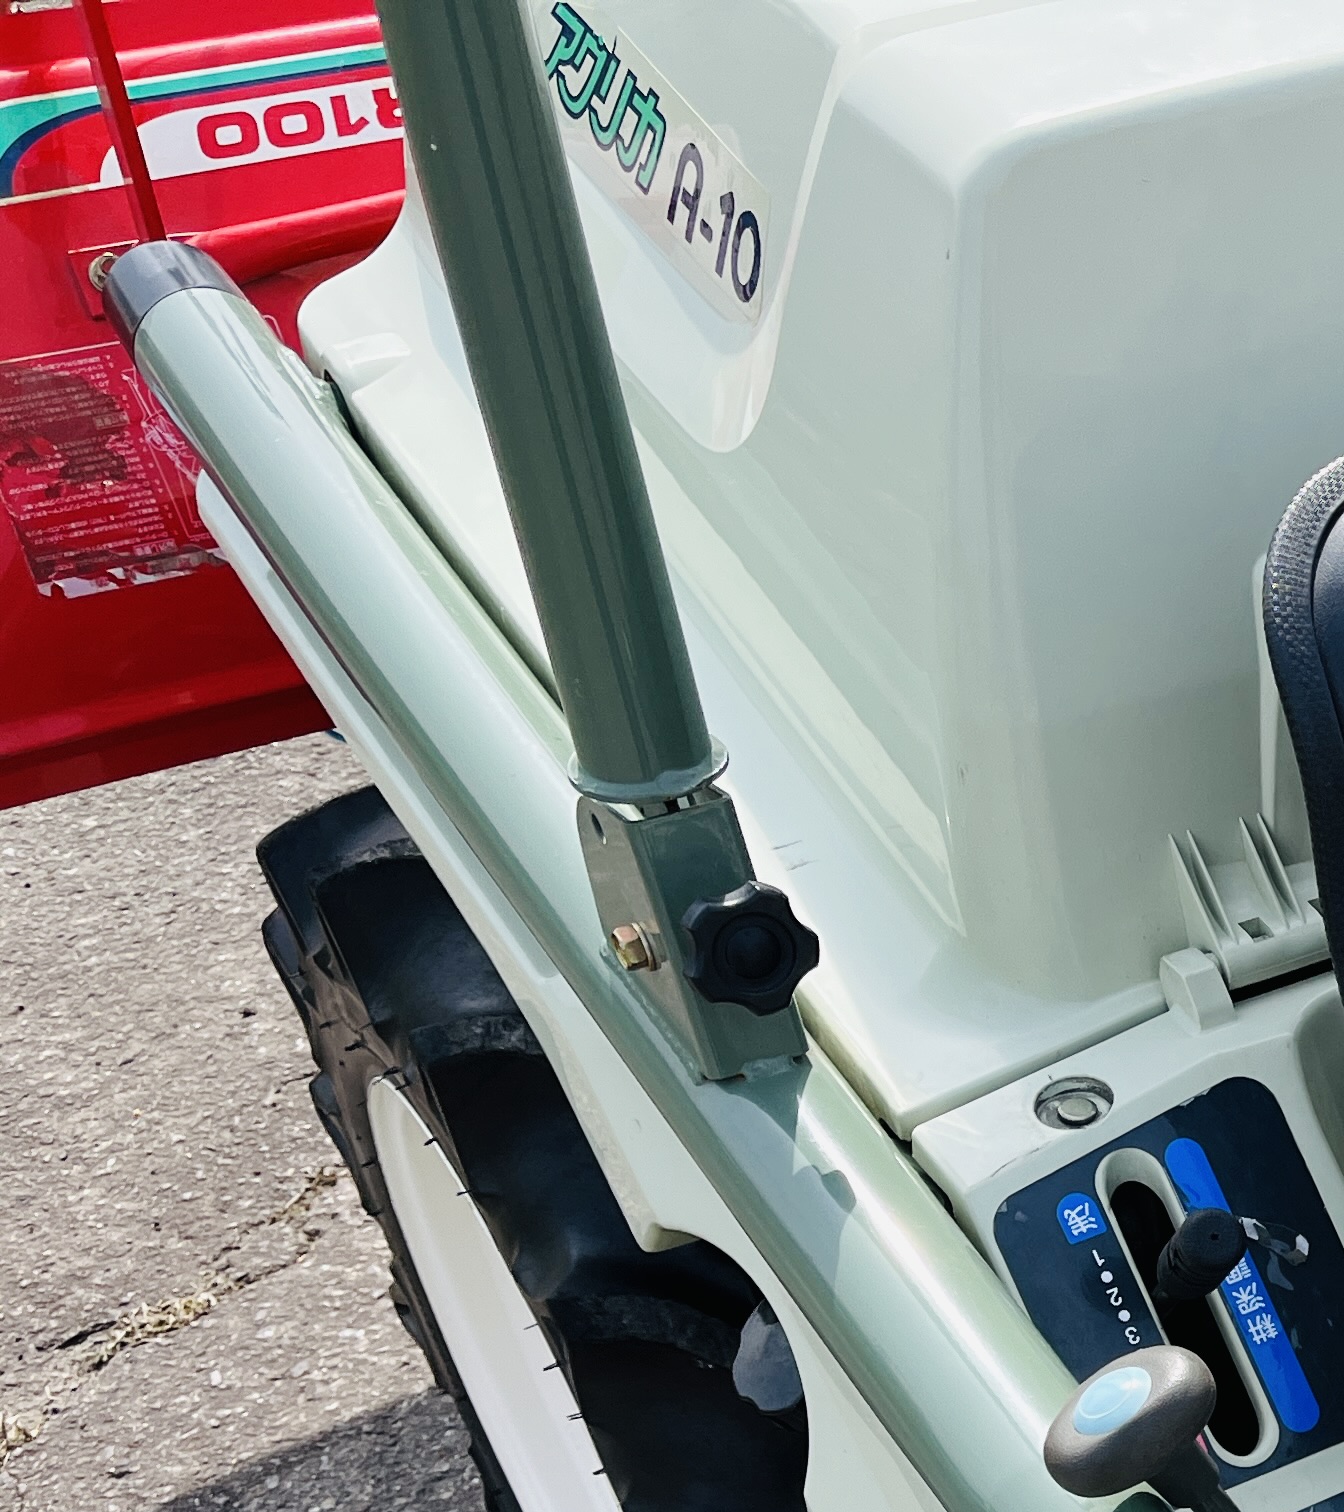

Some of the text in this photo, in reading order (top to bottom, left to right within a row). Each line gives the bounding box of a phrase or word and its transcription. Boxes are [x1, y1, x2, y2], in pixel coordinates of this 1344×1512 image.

[545, 2, 761, 303] アグリカ A-10
[1063, 1202, 1098, 1236] 浅
[1092, 1249, 1105, 1267] 1
[1106, 1286, 1123, 1306] 2
[1124, 1326, 1141, 1345] 3
